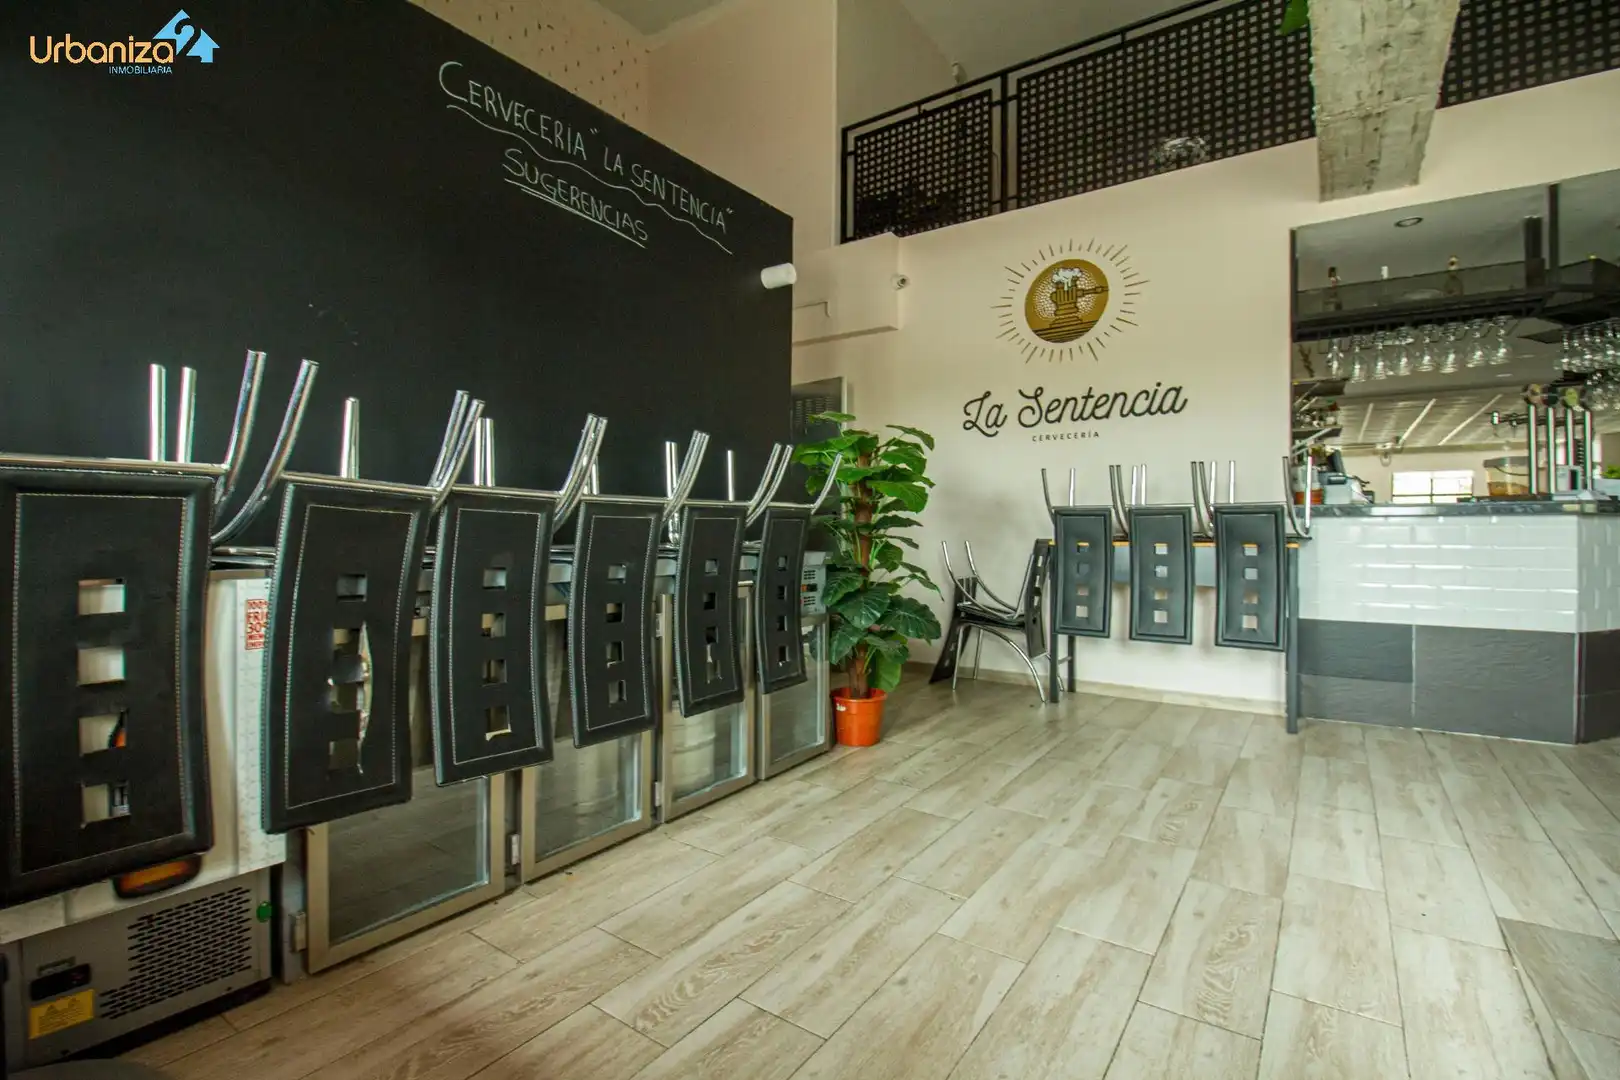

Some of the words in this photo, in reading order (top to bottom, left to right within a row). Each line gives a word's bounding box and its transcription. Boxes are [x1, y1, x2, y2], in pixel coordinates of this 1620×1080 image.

[501, 147, 649, 242] SUGERENCIAS
[962, 390, 1008, 438] La
[1017, 381, 1189, 429] Sentencia
[1031, 430, 1100, 442] CERVECERÍA
